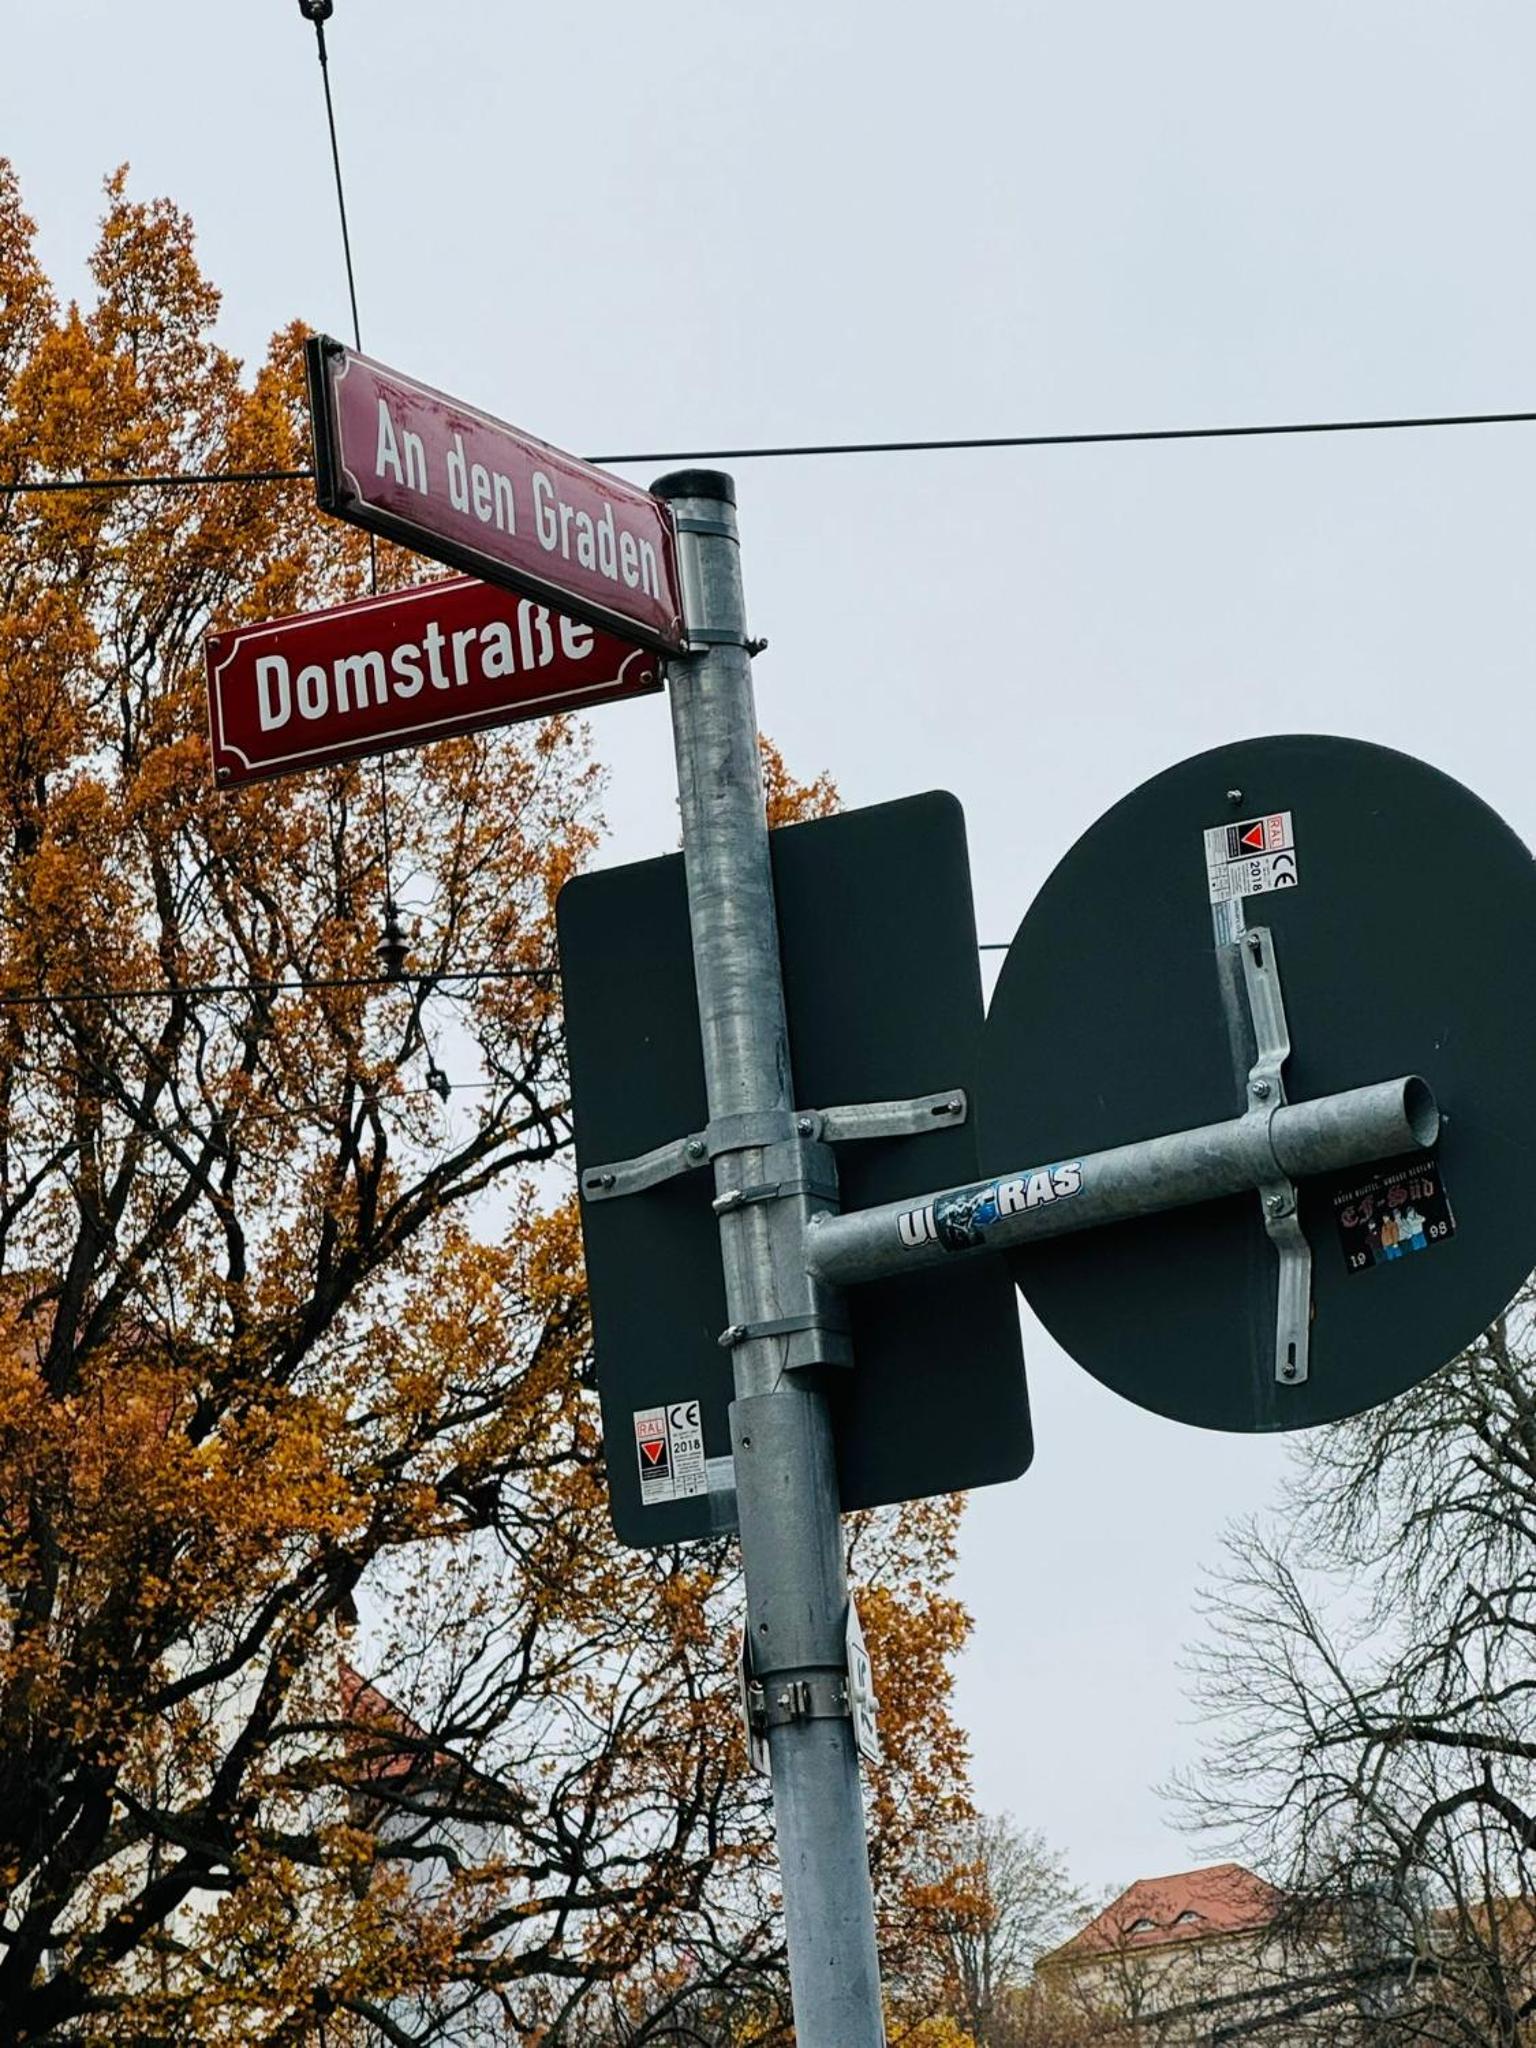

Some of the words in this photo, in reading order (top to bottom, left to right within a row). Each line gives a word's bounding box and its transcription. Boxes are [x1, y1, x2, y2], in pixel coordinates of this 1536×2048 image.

[376, 398, 429, 496] An
[447, 433, 516, 535] den
[533, 470, 661, 600] Graden
[256, 598, 595, 732] Domstraße
[1270, 819, 1282, 847] RAL
[1250, 861, 1263, 891] 2018
[1272, 854, 1297, 888] CE
[898, 1162, 1082, 1247] URAS
[640, 1421, 663, 1435] RAL
[670, 1402, 700, 1430] CE
[673, 1439, 701, 1454] 2018
